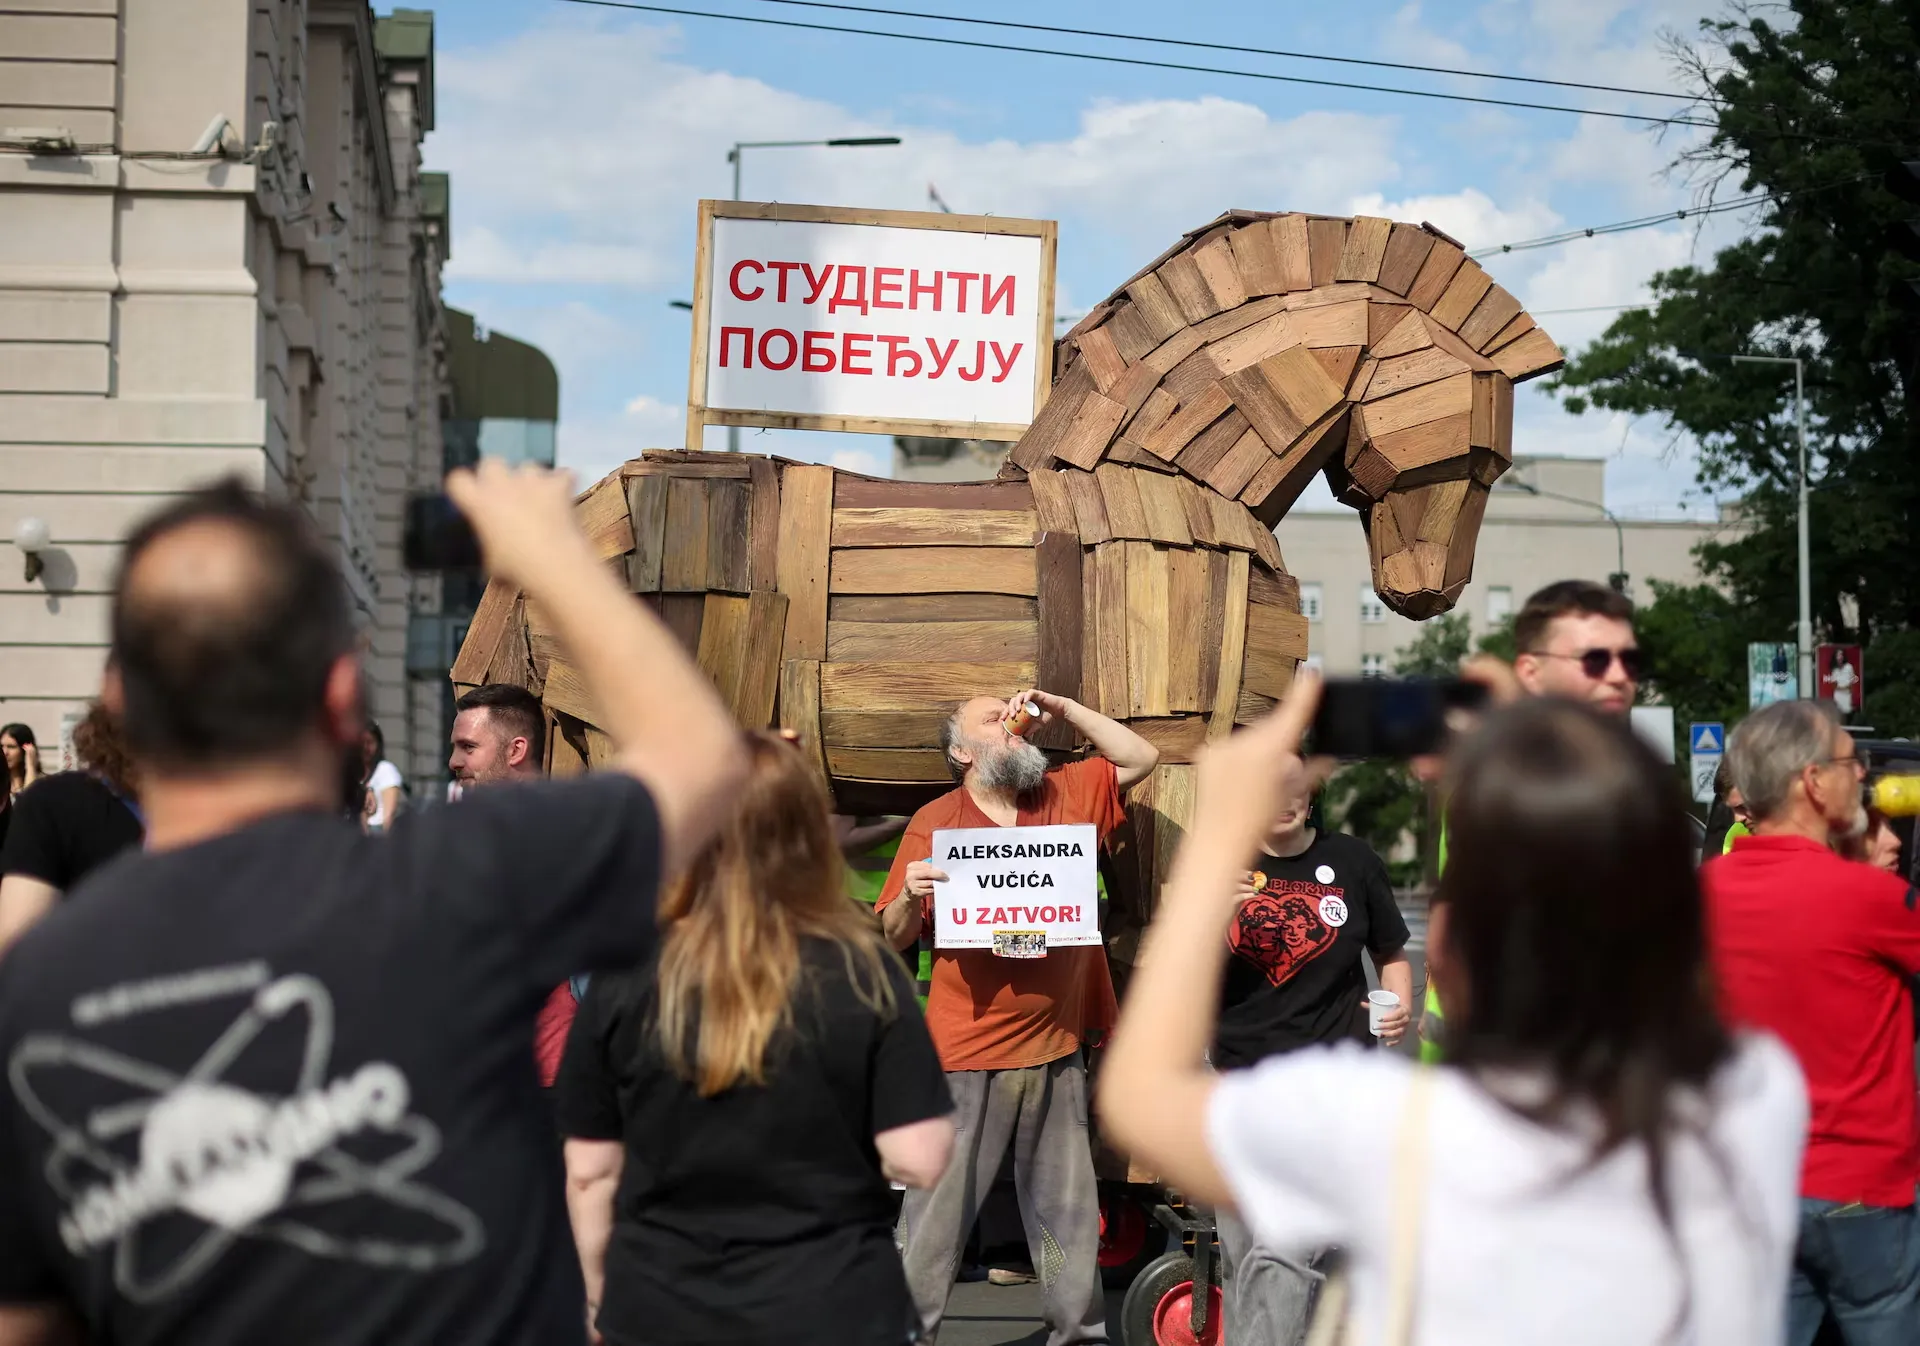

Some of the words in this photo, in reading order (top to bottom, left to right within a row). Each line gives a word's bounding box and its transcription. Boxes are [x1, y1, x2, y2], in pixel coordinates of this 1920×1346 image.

[729, 259, 1016, 316] СТУДЕНТИ
[719, 326, 1024, 383] ПОБЕЂУЈУ
[947, 843, 1083, 860] ALEKSANDRA
[977, 870, 1054, 888] VUČIĆA
[952, 908, 967, 925] U
[976, 905, 1081, 924] ZATVOR!
